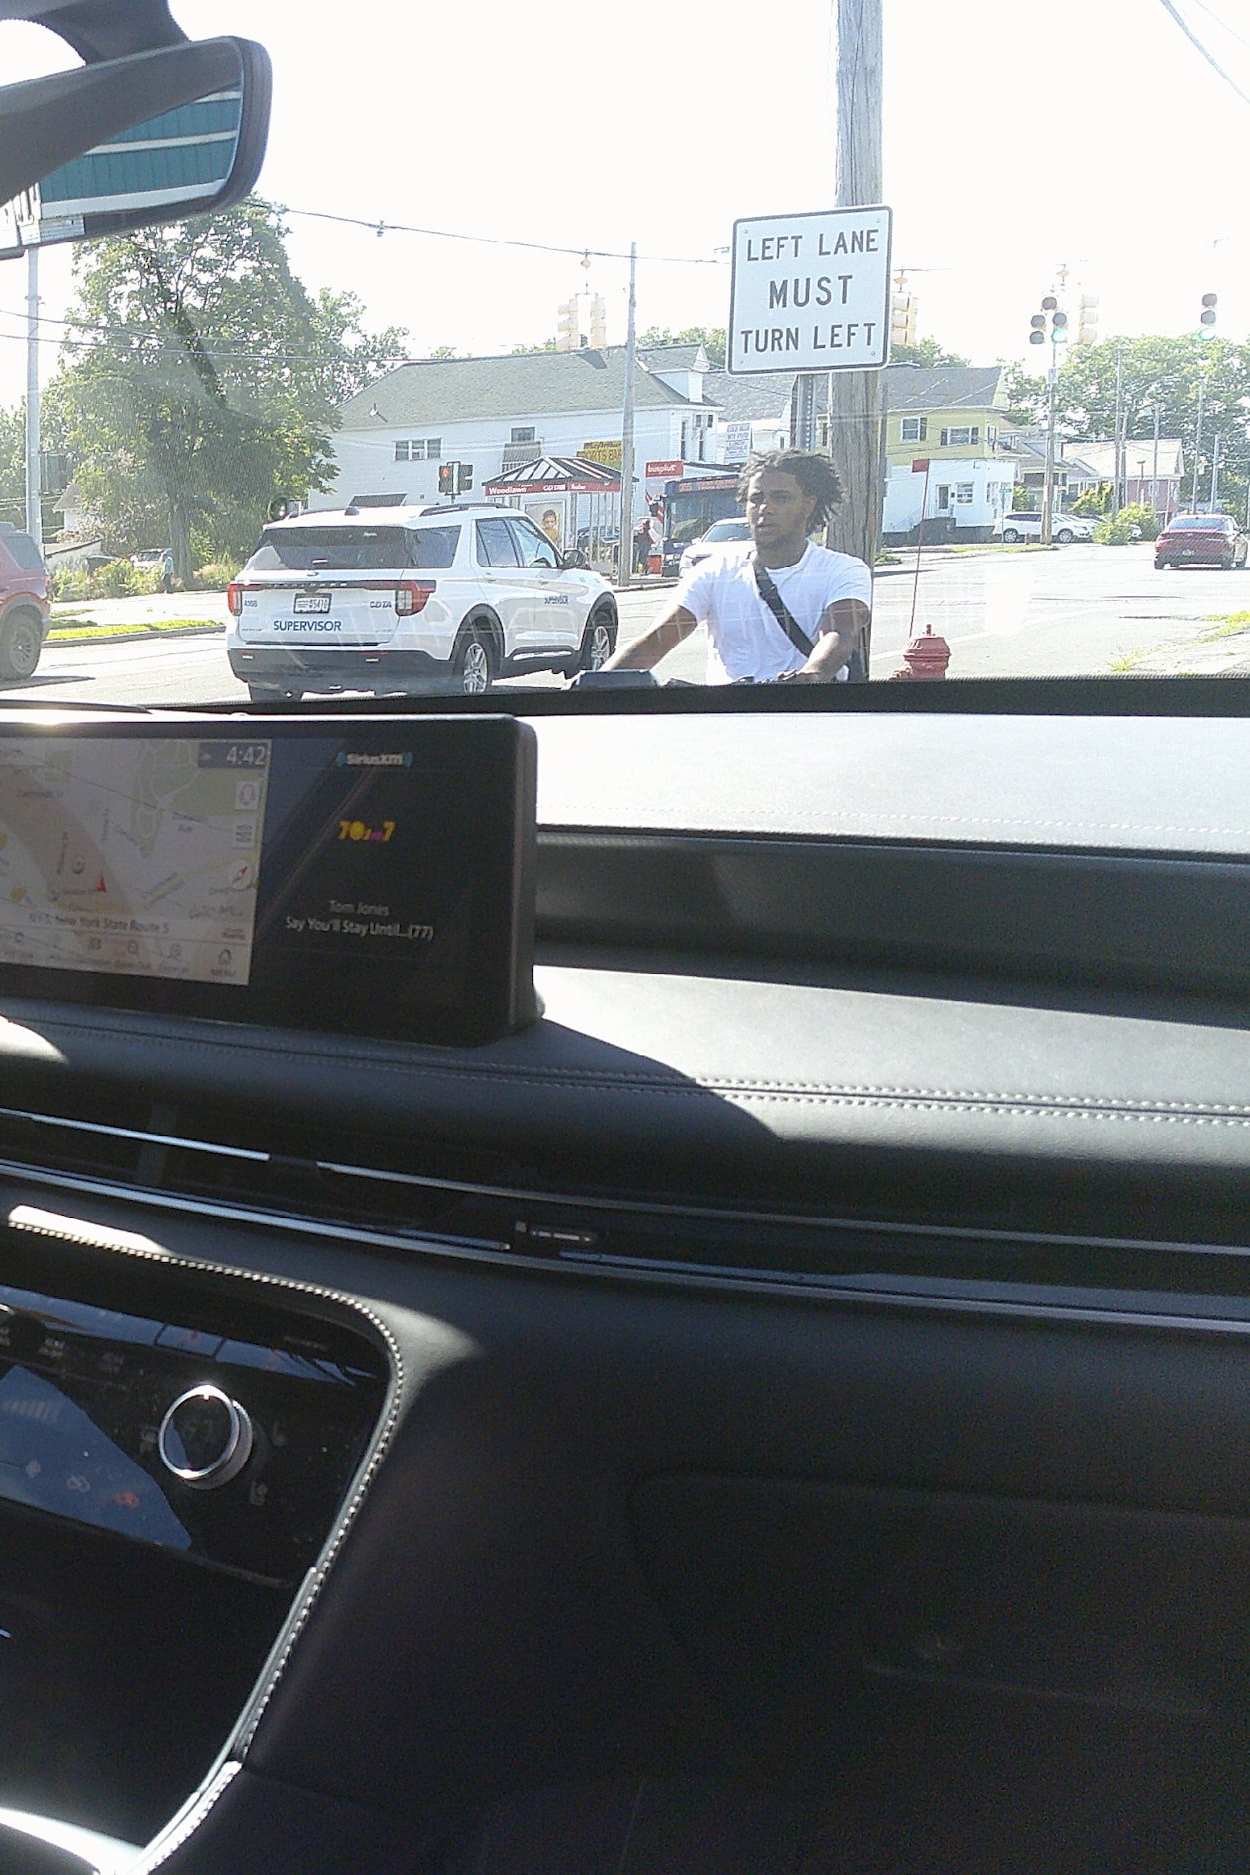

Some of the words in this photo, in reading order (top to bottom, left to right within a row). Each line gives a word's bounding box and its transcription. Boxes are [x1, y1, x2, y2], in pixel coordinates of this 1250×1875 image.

[747, 235, 803, 262] LEFT
[818, 229, 879, 256] LANE
[769, 275, 853, 309] MUST
[741, 327, 799, 354] TURN
[813, 322, 877, 350] LEFT
[647, 464, 677, 475] busplus
[489, 485, 527, 495] Woodlawn
[273, 620, 342, 632] SUPERVISOR
[226, 746, 266, 765] 4:42
[330, 900, 355, 913] Tom
[356, 902, 390, 917] Jones
[78, 916, 101, 928] York
[103, 918, 128, 930] State
[130, 919, 160, 933] Route
[286, 916, 306, 931] Say
[307, 917, 340, 932] You'll
[342, 919, 369, 937] Stay
